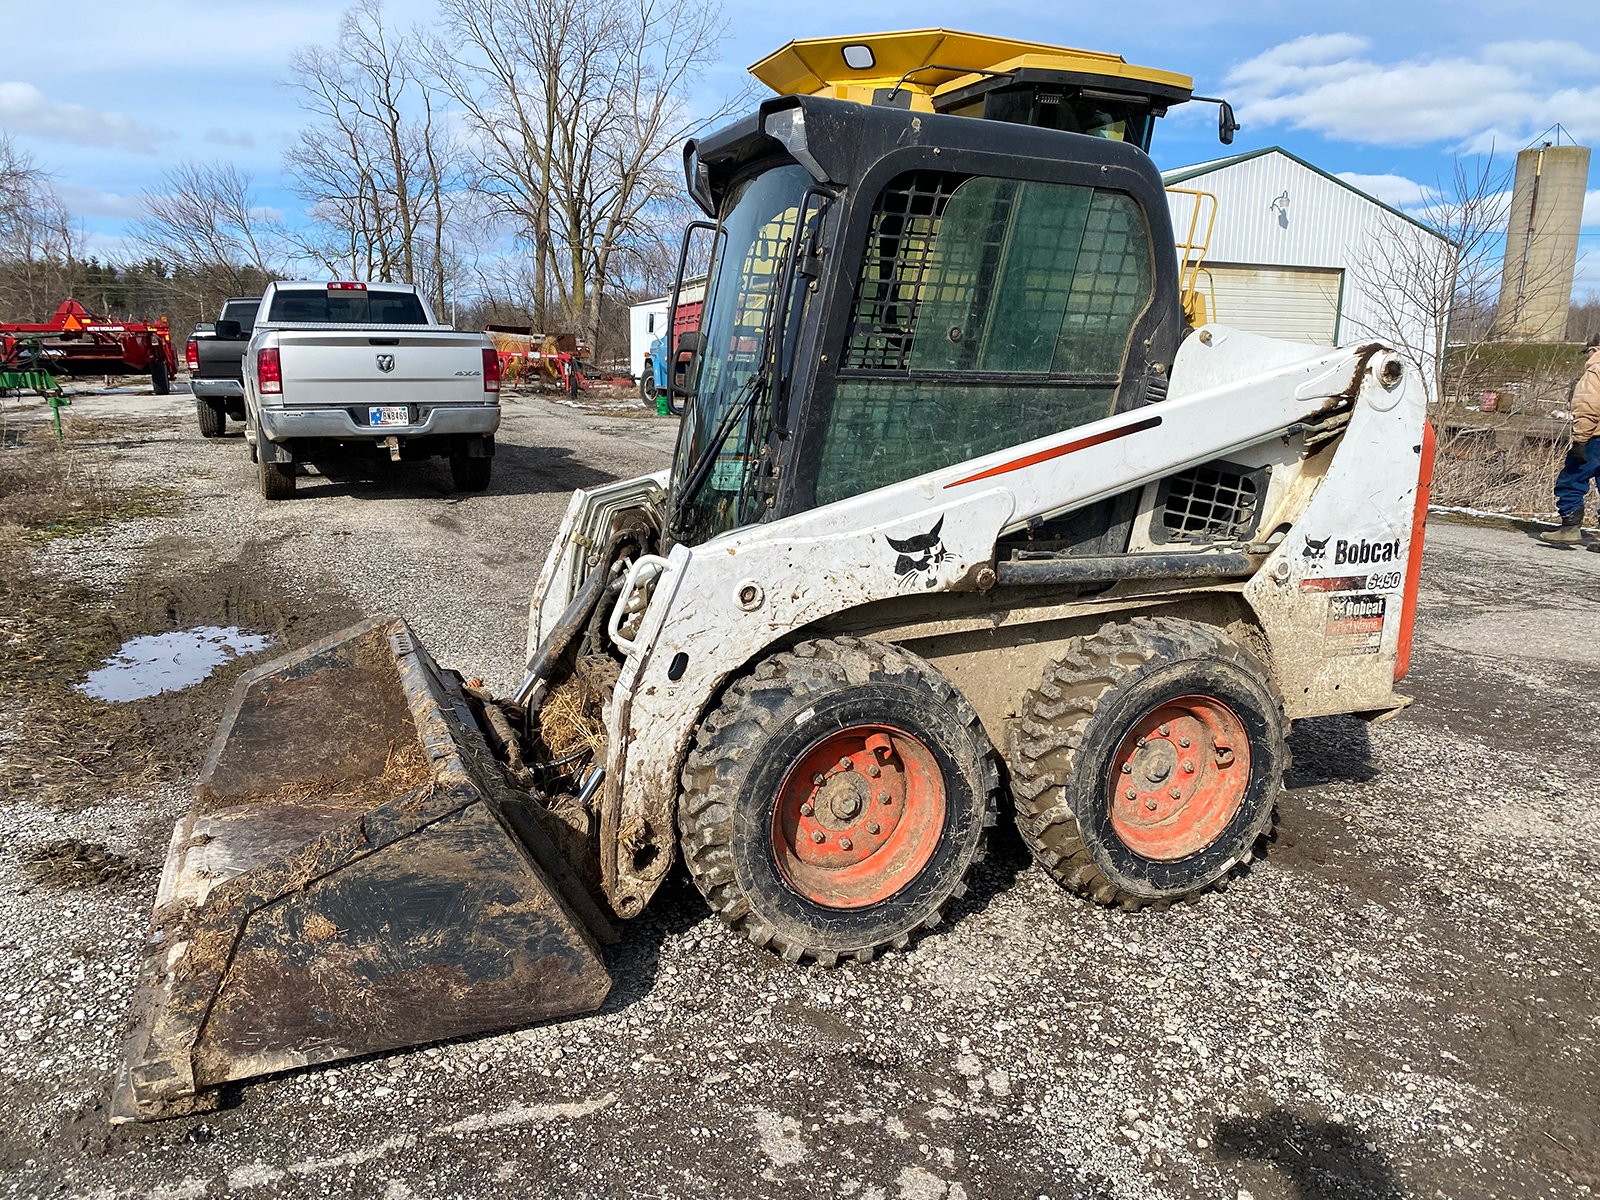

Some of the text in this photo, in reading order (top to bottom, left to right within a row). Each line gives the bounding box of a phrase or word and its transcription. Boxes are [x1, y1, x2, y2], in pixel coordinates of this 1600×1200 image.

[1334, 538, 1401, 565] Bobcat
[1367, 571, 1401, 590] S450
[1346, 600, 1383, 617] Bobcat
[1354, 619, 1378, 631] Wayne
